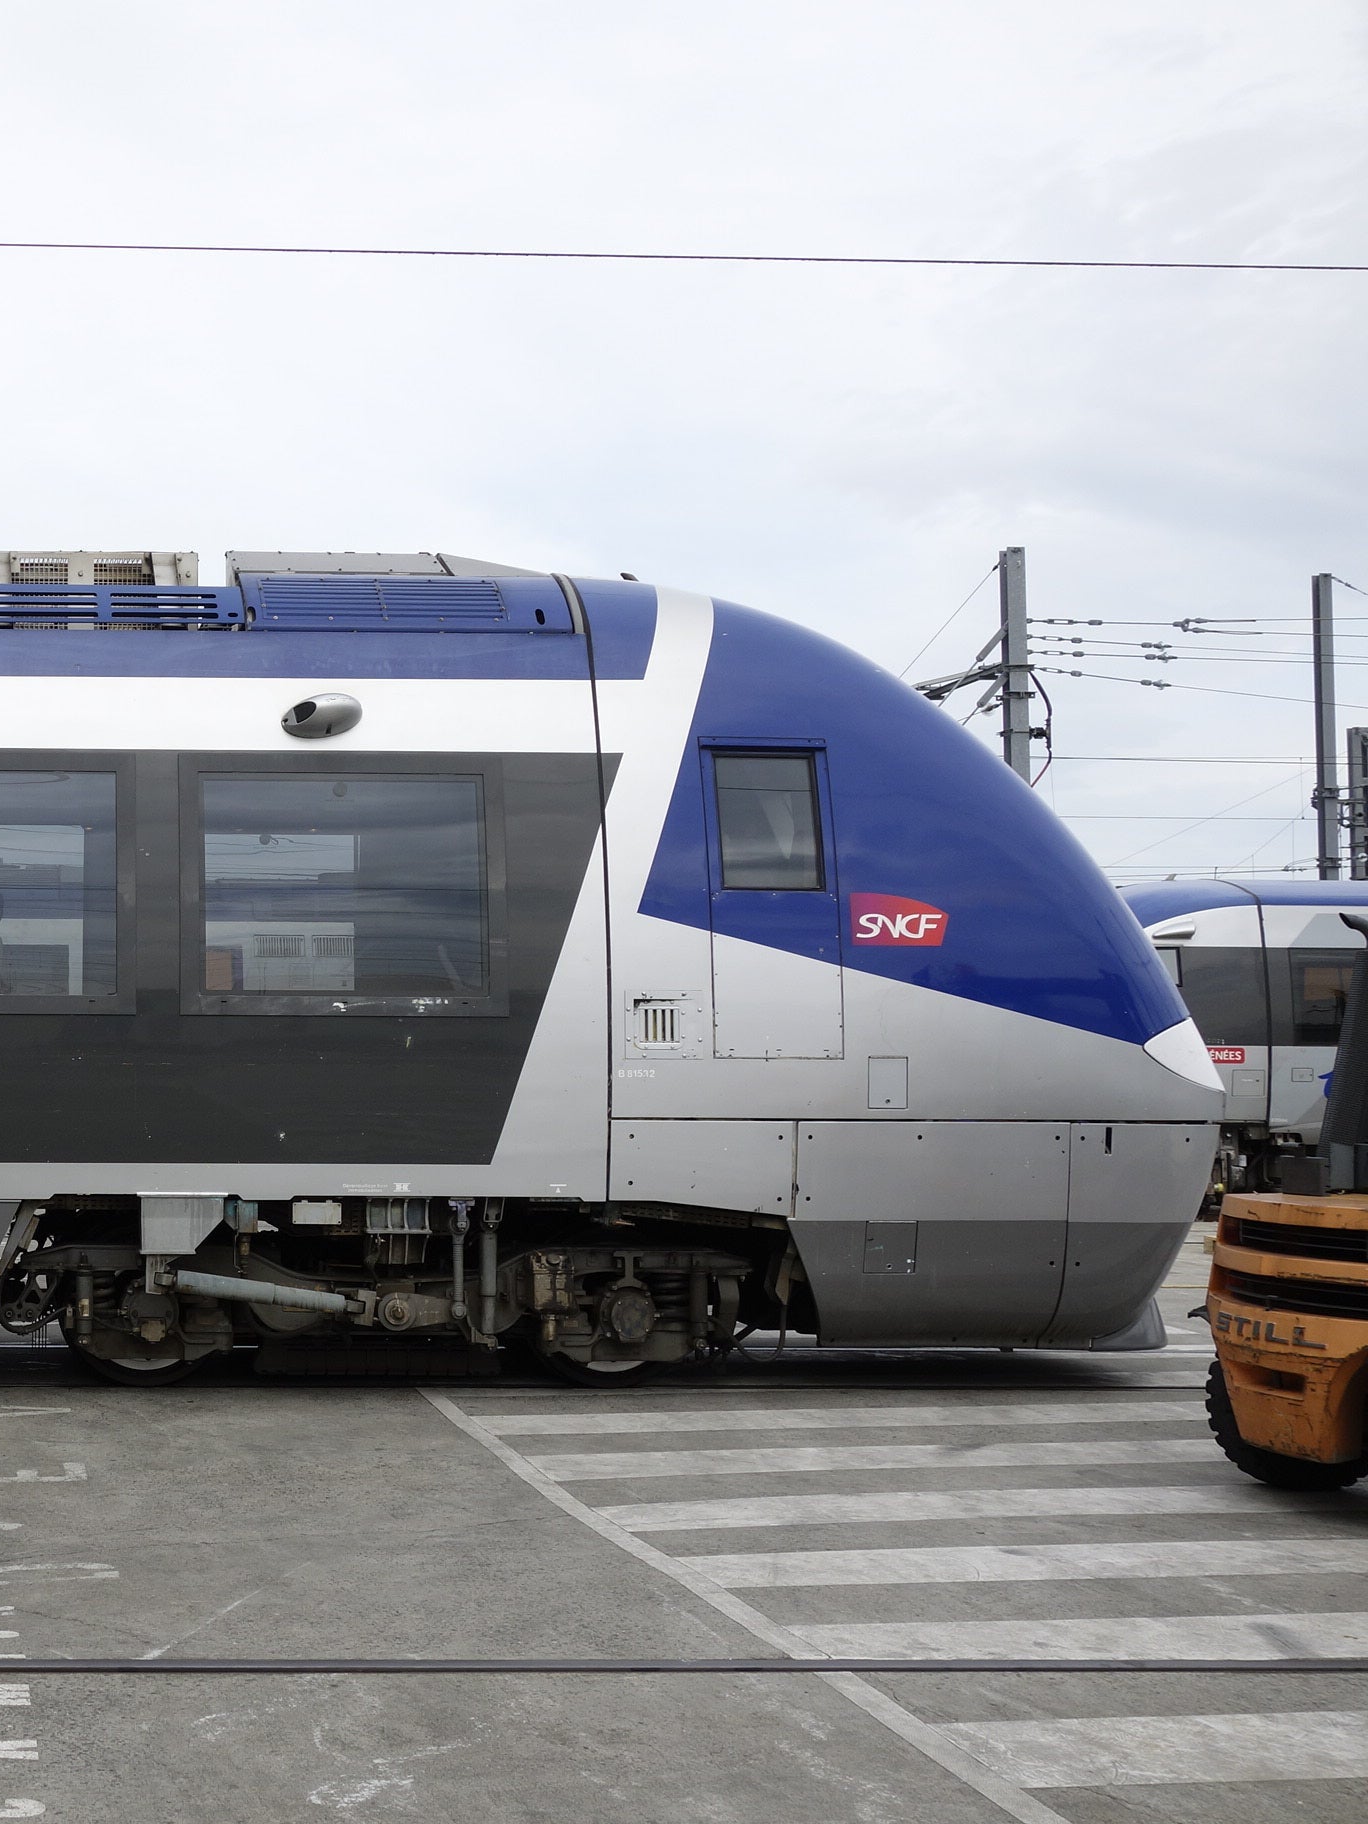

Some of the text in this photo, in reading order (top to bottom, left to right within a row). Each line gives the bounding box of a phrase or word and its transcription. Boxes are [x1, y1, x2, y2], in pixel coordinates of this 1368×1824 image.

[856, 913, 942, 939] SNCF
[1209, 1049, 1242, 1060] ÉNÉES
[1215, 1311, 1327, 1350] STILL
